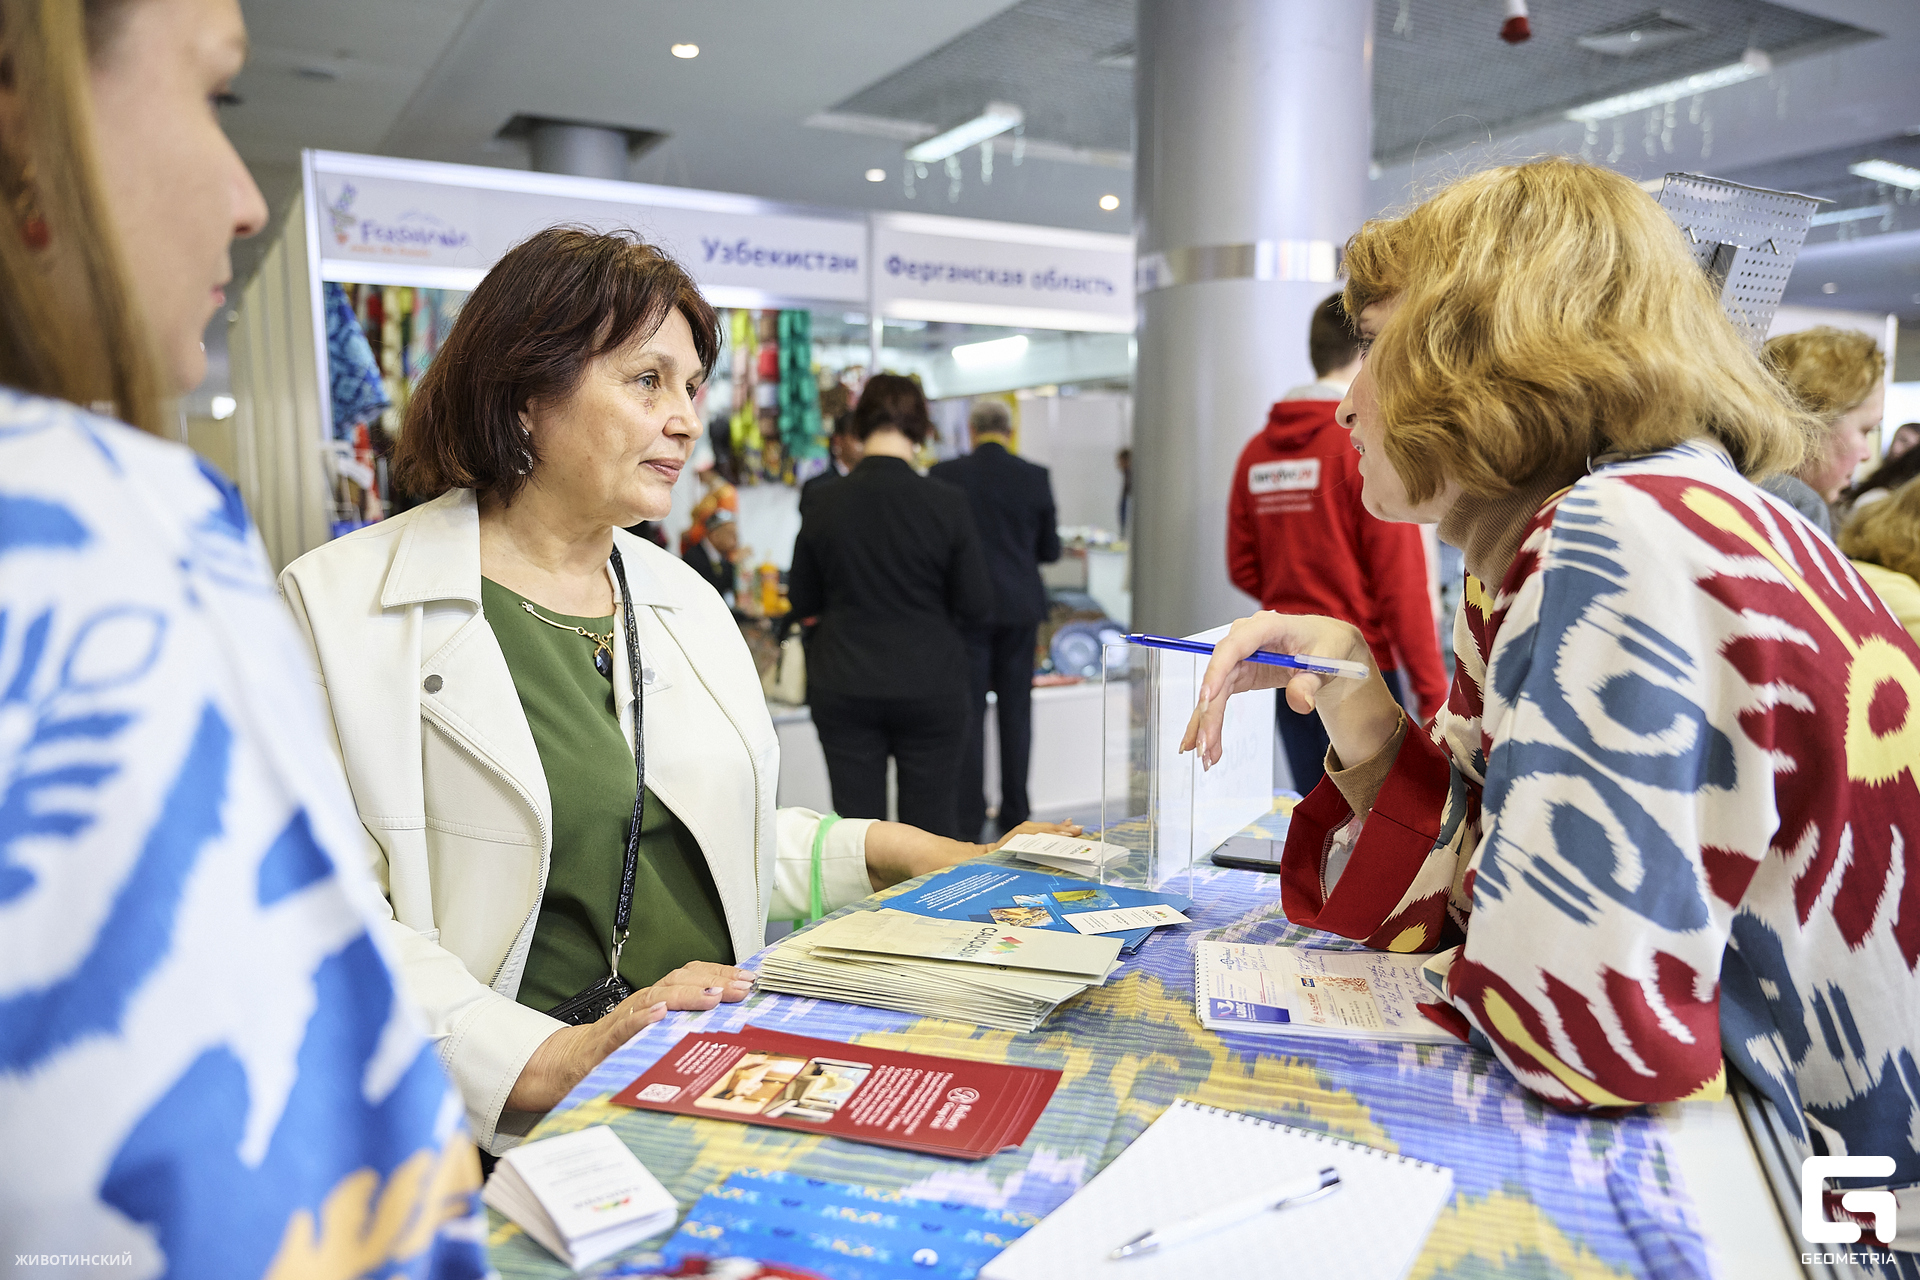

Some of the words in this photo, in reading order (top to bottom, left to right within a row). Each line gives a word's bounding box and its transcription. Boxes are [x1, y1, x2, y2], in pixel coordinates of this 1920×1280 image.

[701, 234, 859, 273] Узбекистан
[885, 254, 1024, 288] Ферганская
[1030, 266, 1116, 295] область
[957, 927, 998, 957] CAUCASIA
